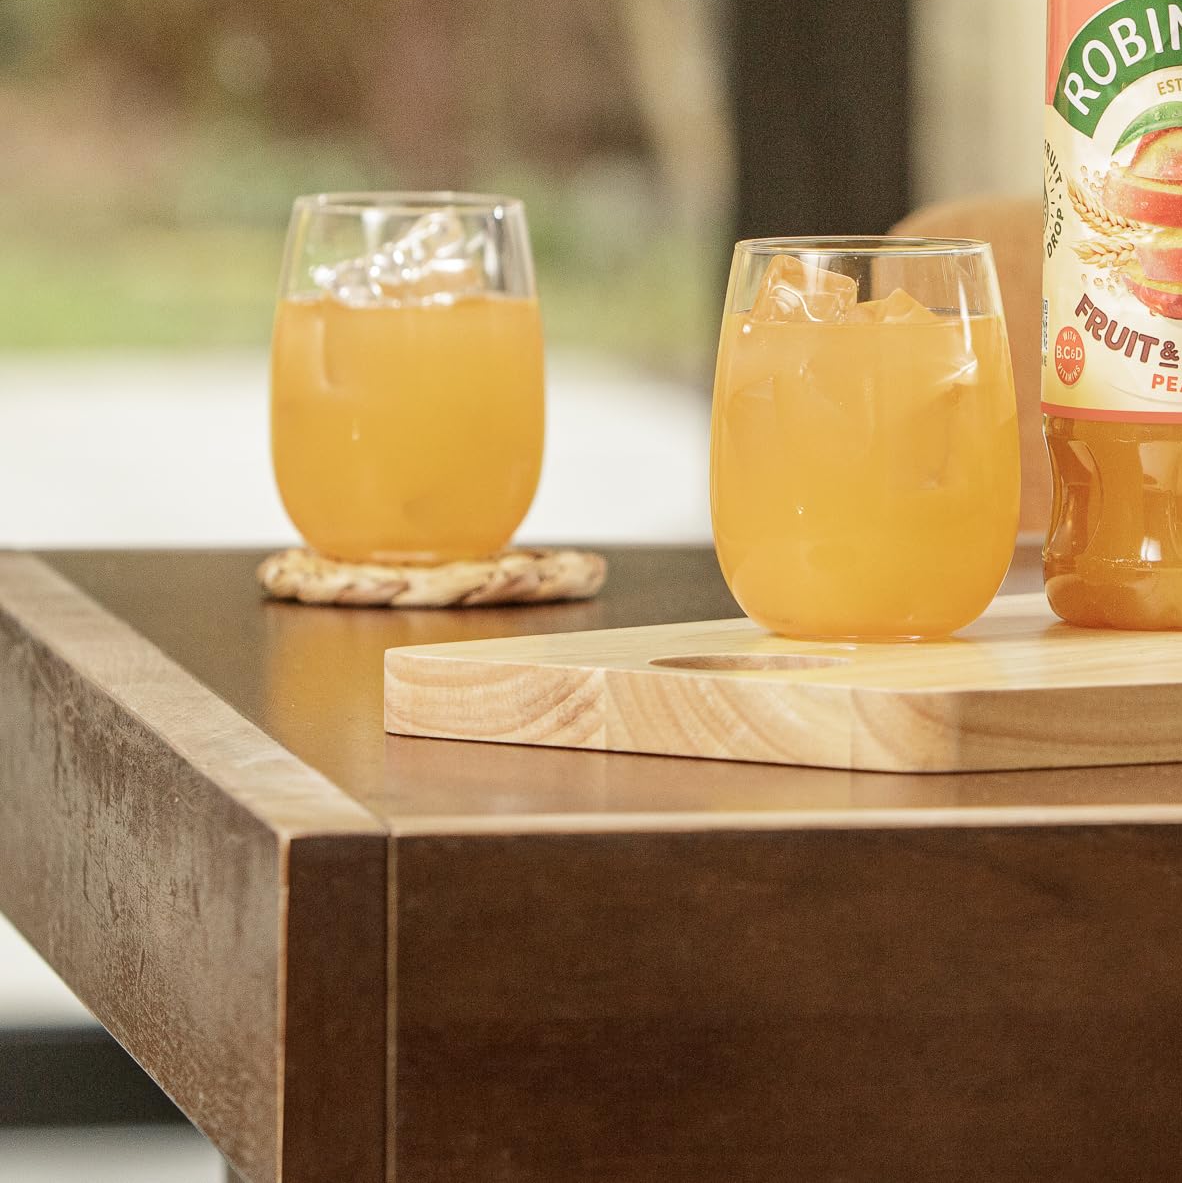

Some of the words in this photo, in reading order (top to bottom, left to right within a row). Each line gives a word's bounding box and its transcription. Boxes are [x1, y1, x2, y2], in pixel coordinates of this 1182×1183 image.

[1046, 208, 1064, 259] DROP
[1063, 330, 1077, 343] WITH
[1074, 293, 1160, 364] FRUIT
[1159, 340, 1180, 369] &
[1057, 362, 1081, 382] VITAMINS
